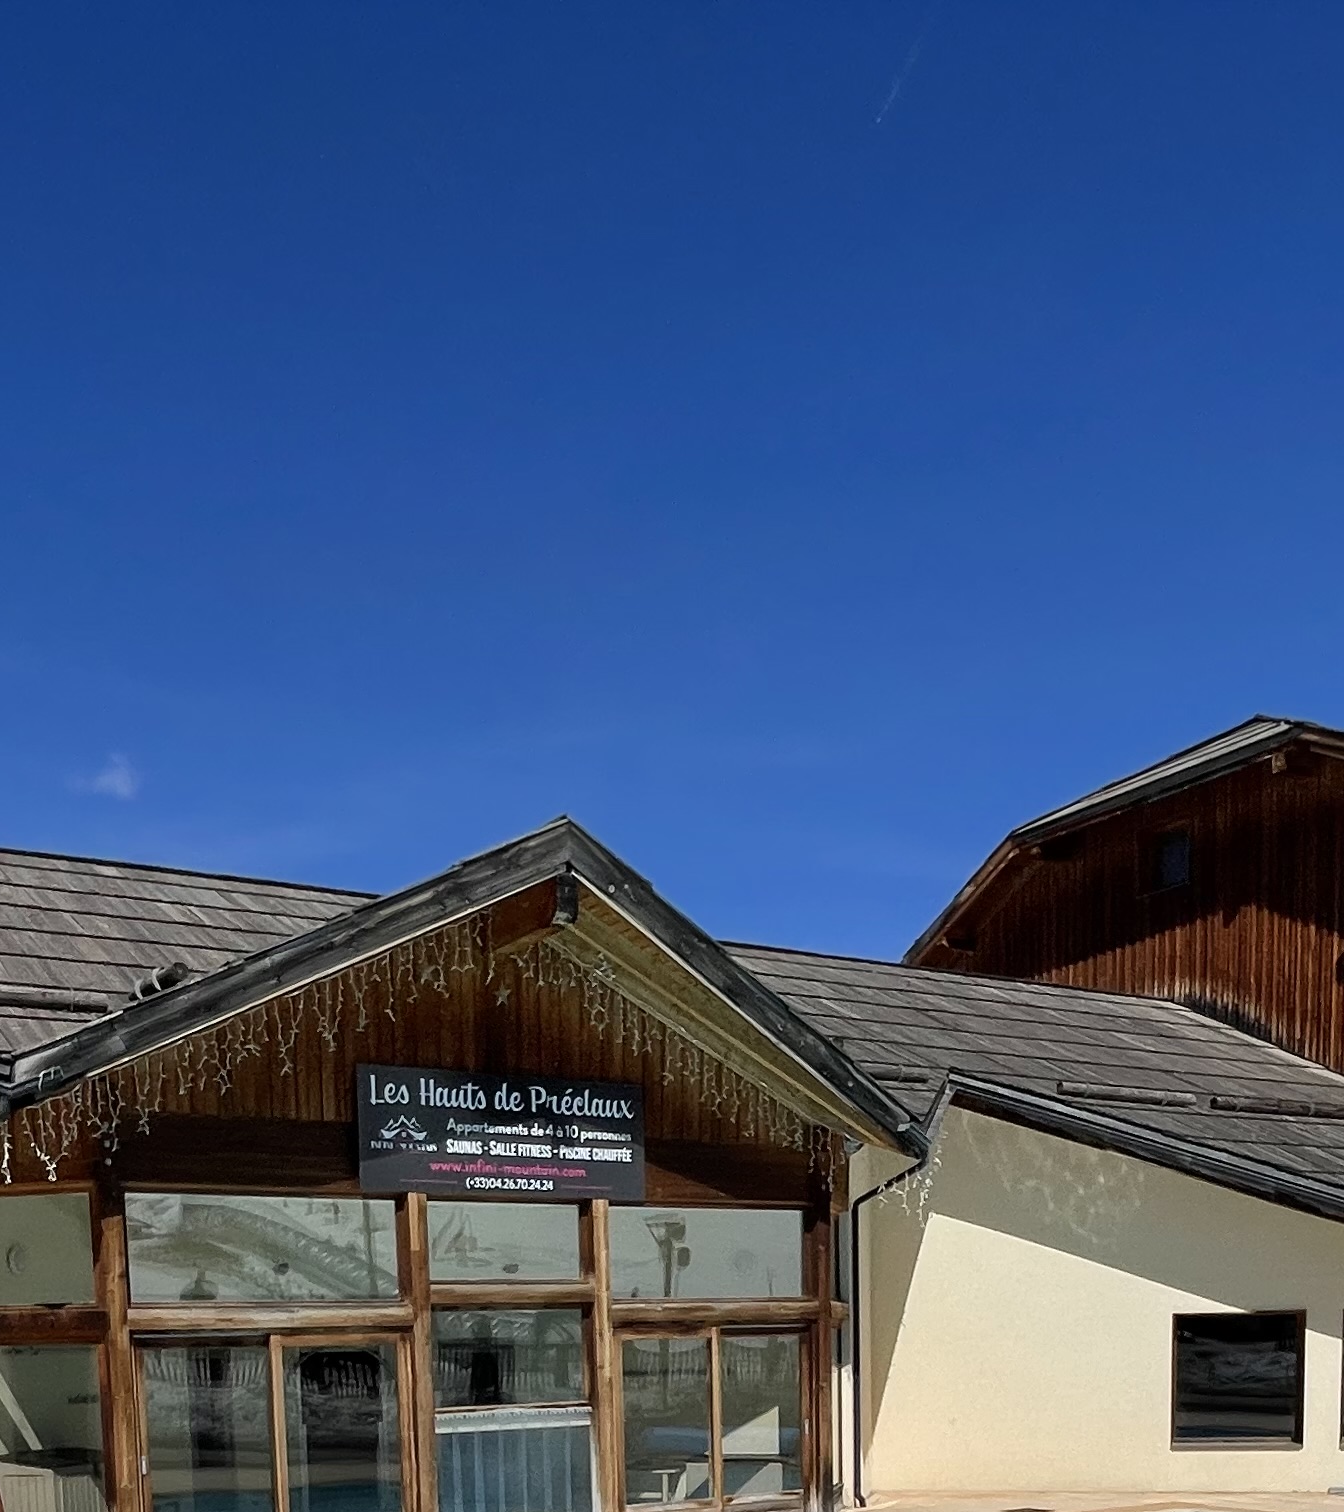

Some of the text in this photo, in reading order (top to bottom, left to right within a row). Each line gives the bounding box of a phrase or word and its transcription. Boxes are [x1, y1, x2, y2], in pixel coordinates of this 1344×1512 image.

[370, 1074, 635, 1119] Les Hauts de Préclaux
[447, 1118, 632, 1143] Appartements de 4 à 10 personnes
[447, 1138, 483, 1154] SAUNAS
[489, 1140, 517, 1156] SALLE
[518, 1143, 552, 1158] FITNESS
[559, 1145, 591, 1160] PISCINE
[592, 1147, 633, 1162] CHAUFFÉE
[429, 1158, 587, 1177] www.infini-mountain.com
